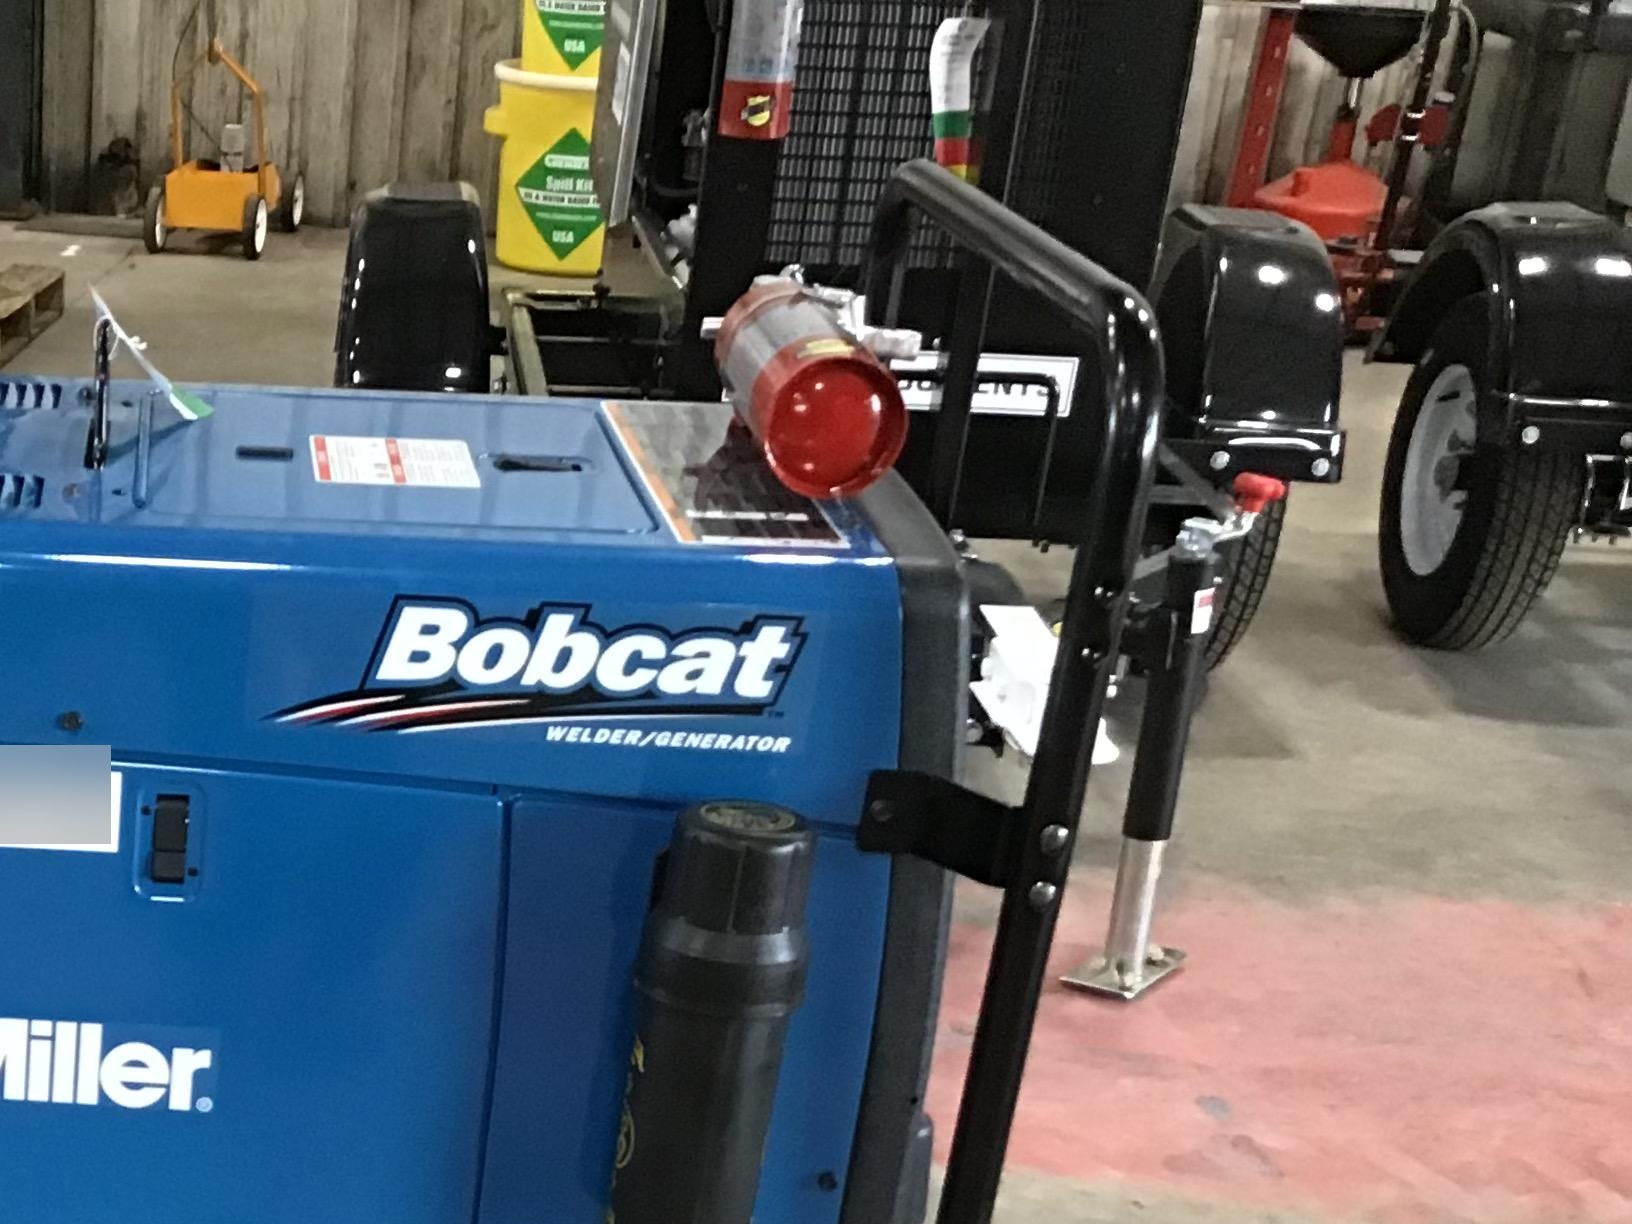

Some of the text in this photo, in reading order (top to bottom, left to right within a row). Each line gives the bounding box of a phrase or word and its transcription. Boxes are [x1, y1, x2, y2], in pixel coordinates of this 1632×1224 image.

[552, 230, 574, 243] USA
[373, 603, 793, 699] Bobcat
[545, 725, 792, 753] WELDER/GENERATOR
